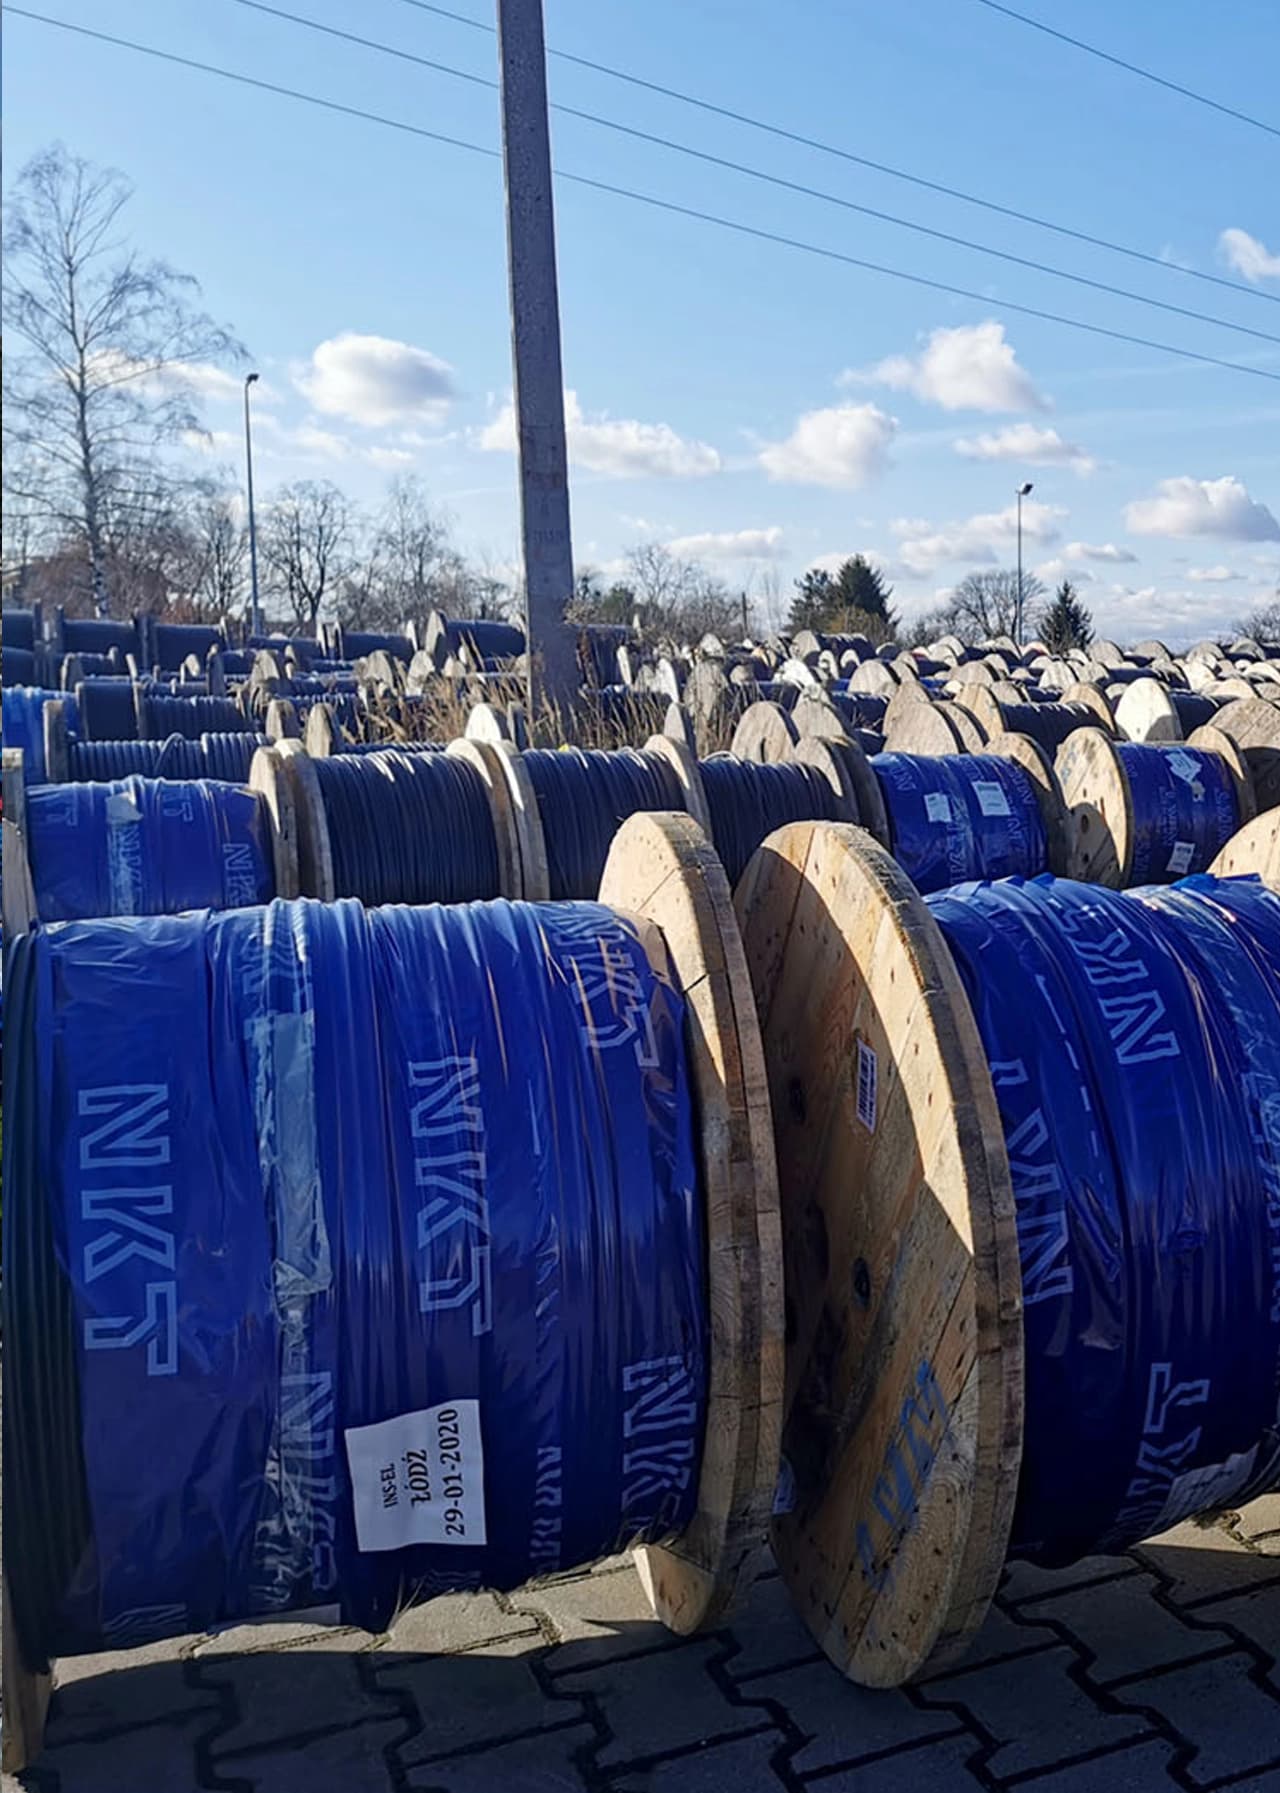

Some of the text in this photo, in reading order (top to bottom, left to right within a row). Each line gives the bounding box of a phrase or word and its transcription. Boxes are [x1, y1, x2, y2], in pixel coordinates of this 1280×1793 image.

[78, 1083, 178, 1376] NKT
[406, 1055, 494, 1336] NKT
[379, 1462, 399, 1508] INS-EL
[437, 1409, 465, 1536] 29-01-2020
